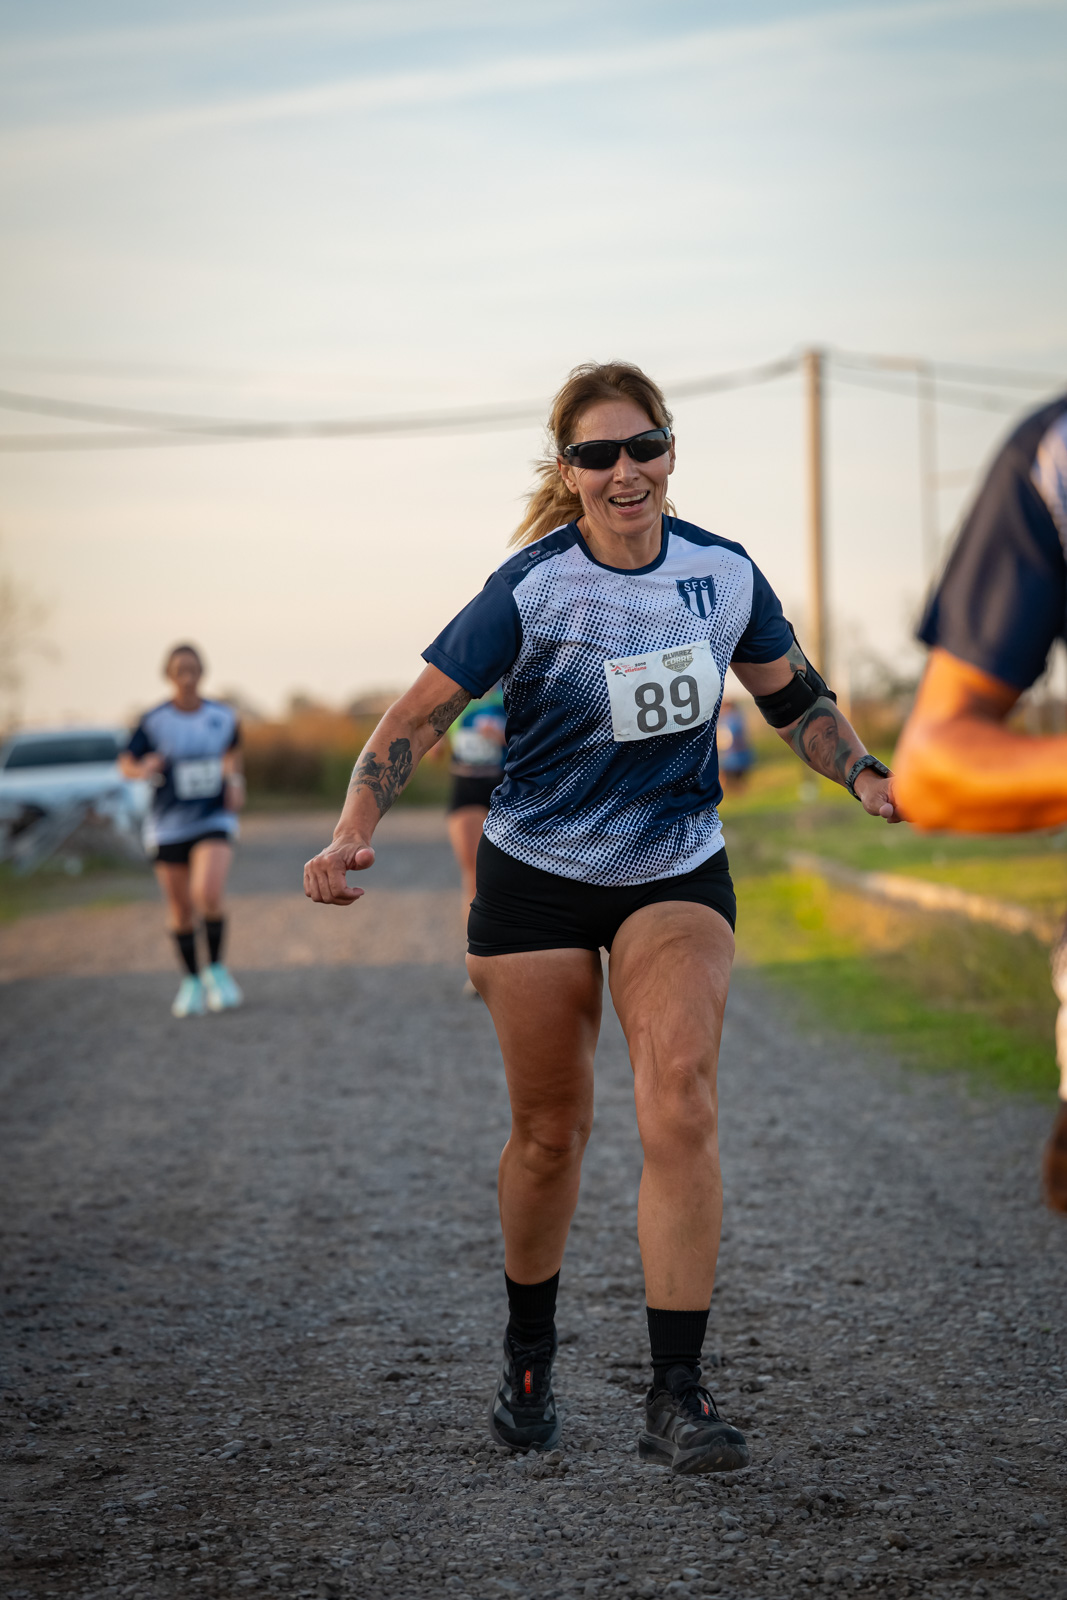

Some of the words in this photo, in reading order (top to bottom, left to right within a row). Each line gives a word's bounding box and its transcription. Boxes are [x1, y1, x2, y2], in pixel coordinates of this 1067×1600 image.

[684, 580, 708, 592] SFC
[662, 649, 692, 660] ALVAREZ
[665, 655, 693, 667] CORRE
[635, 675, 700, 733] 89
